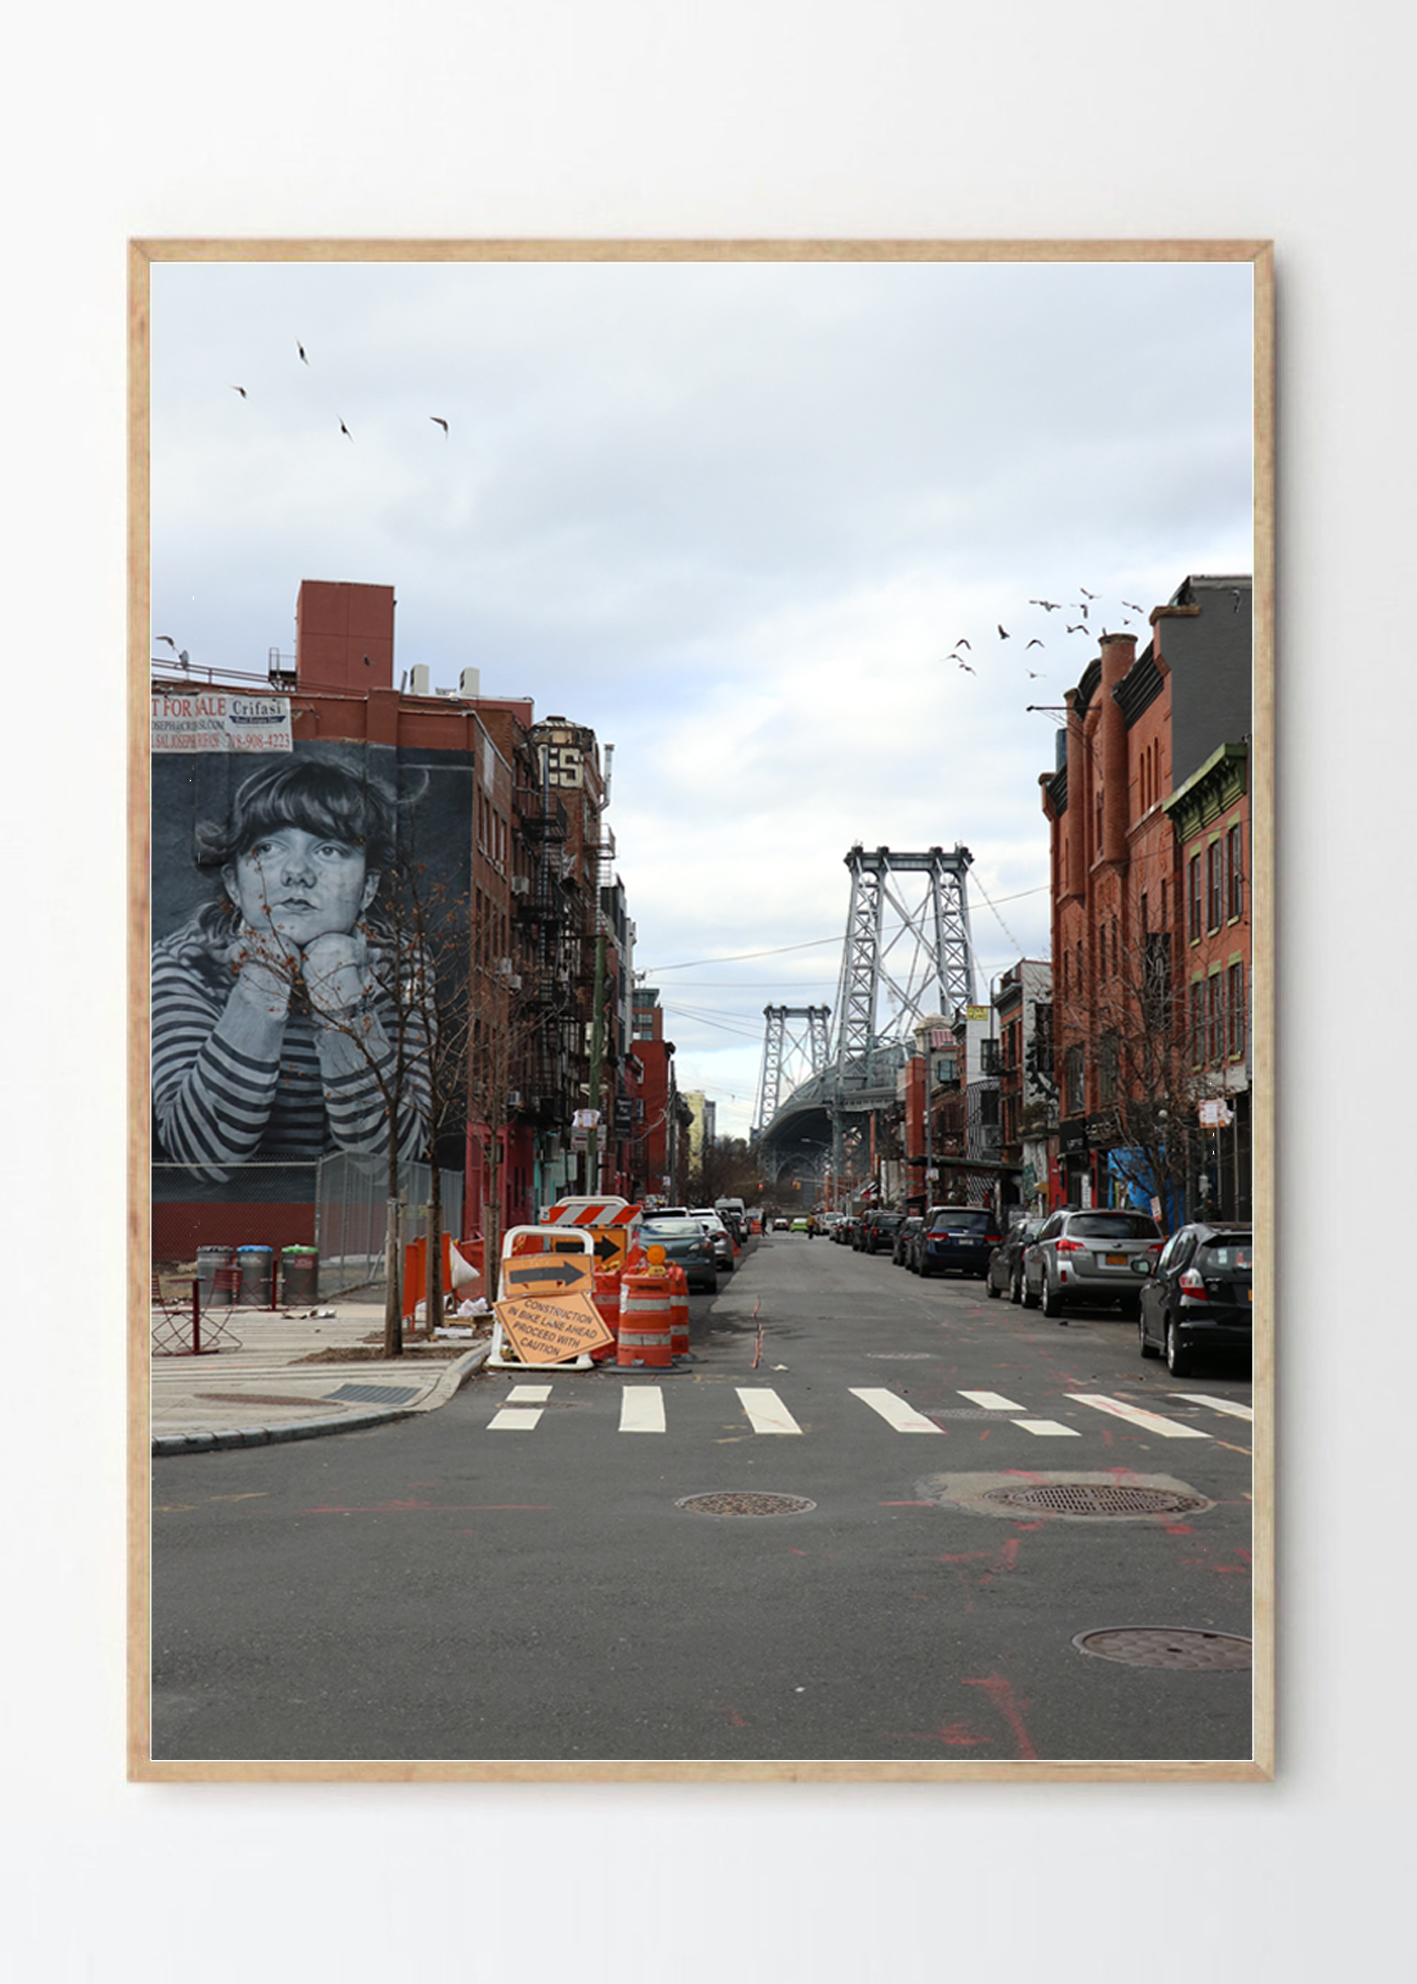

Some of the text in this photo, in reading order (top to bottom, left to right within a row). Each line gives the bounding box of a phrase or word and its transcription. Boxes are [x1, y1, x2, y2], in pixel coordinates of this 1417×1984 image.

[163, 698, 192, 718] FOR
[195, 697, 228, 717] SALE
[232, 700, 282, 715] Crifasi
[171, 734, 196, 749] JOSEPH
[524, 1298, 593, 1325] CONSTRUCTION
[507, 1306, 598, 1339] IN BIKE LANE AHEAD
[512, 1320, 581, 1348] PROCEED WITH
[520, 1337, 561, 1356] CAUTION
